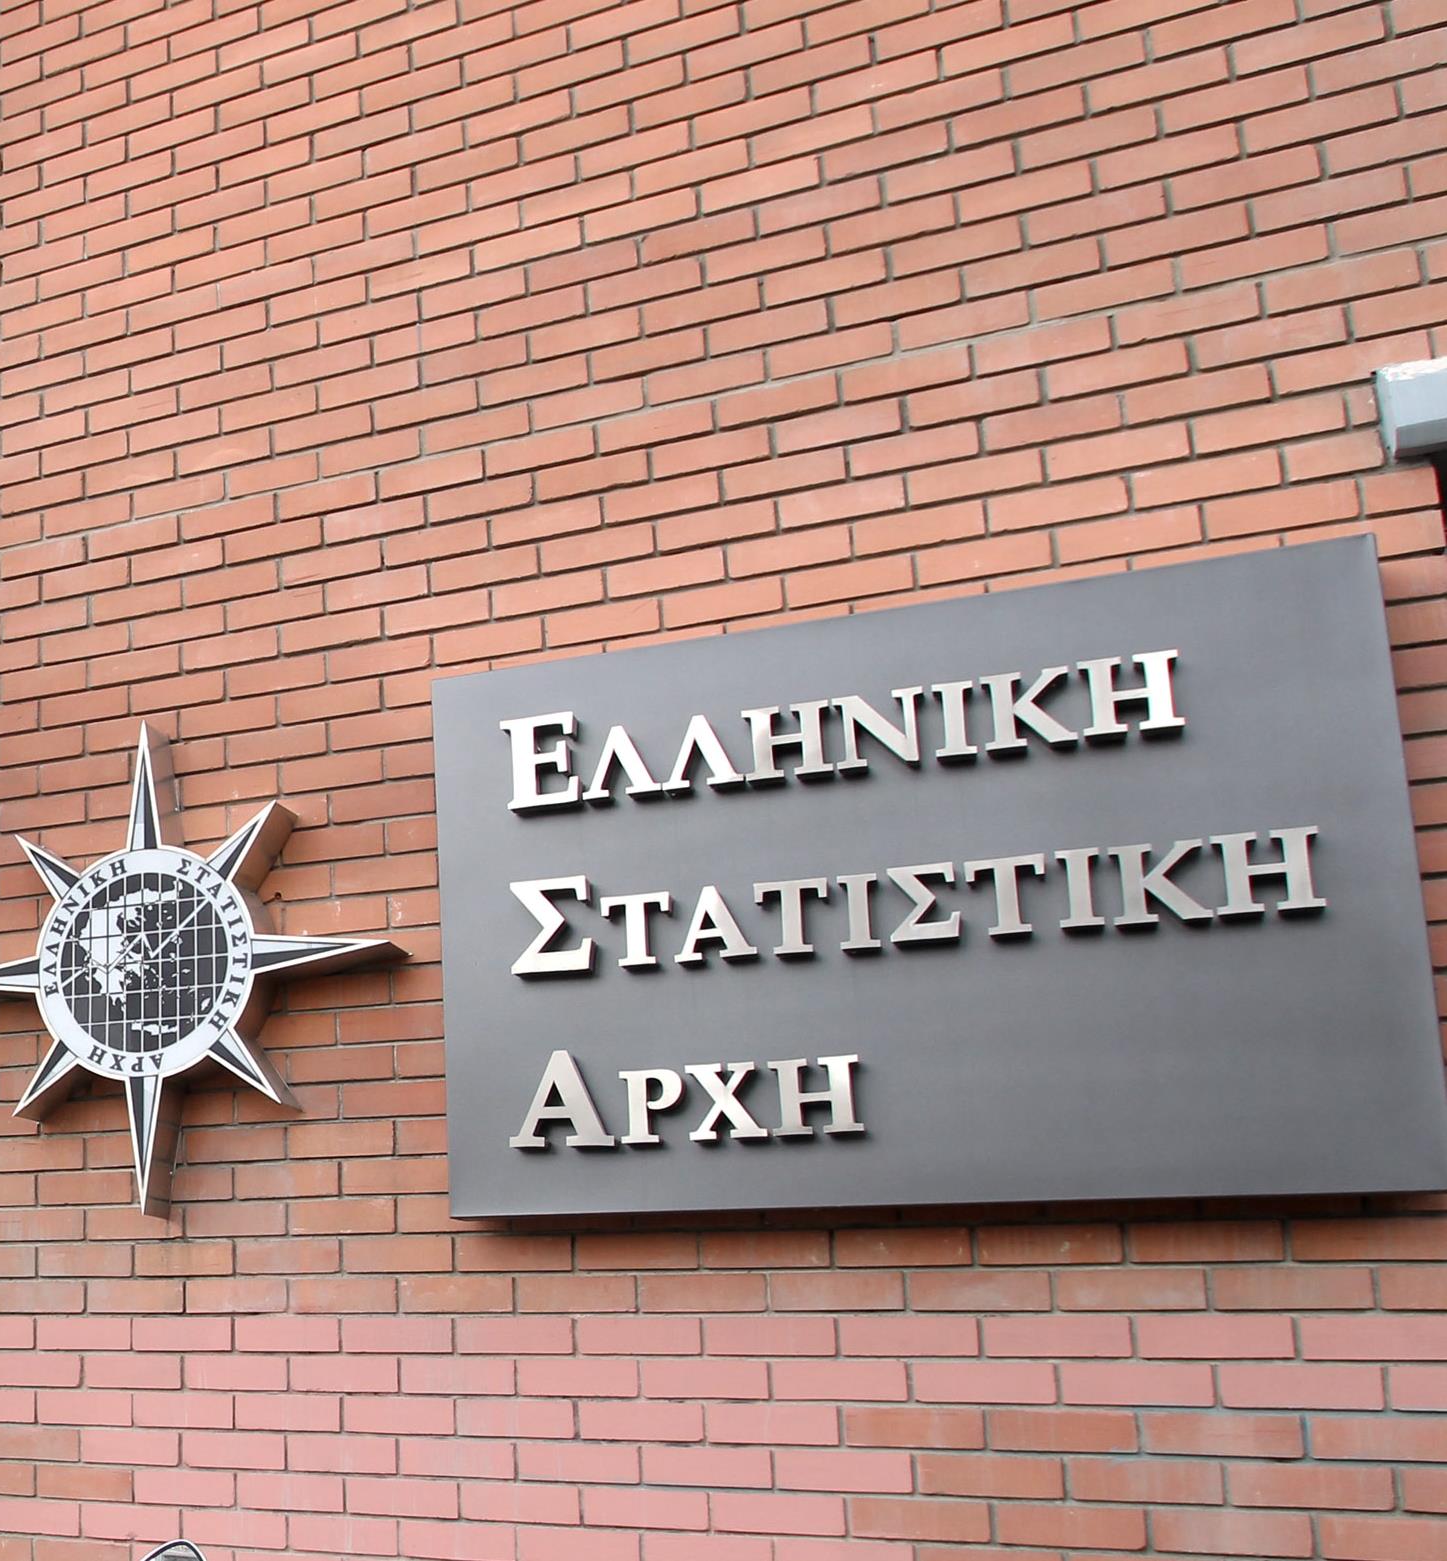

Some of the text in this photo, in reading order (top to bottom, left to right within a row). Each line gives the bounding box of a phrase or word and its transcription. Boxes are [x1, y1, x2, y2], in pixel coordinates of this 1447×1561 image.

[499, 649, 1186, 812] ΕΛΛΗΝΙΚΗ
[44, 858, 248, 1073] ΕΛΛΗΝΙΚΗ ΣΤΑΤΙΣΤΙΚΗ ΑΡΧΗ
[509, 825, 1328, 977] ΣΤΑΤΙΣΤΙΚΗ
[509, 1050, 865, 1150] ΑΡΧΗ
